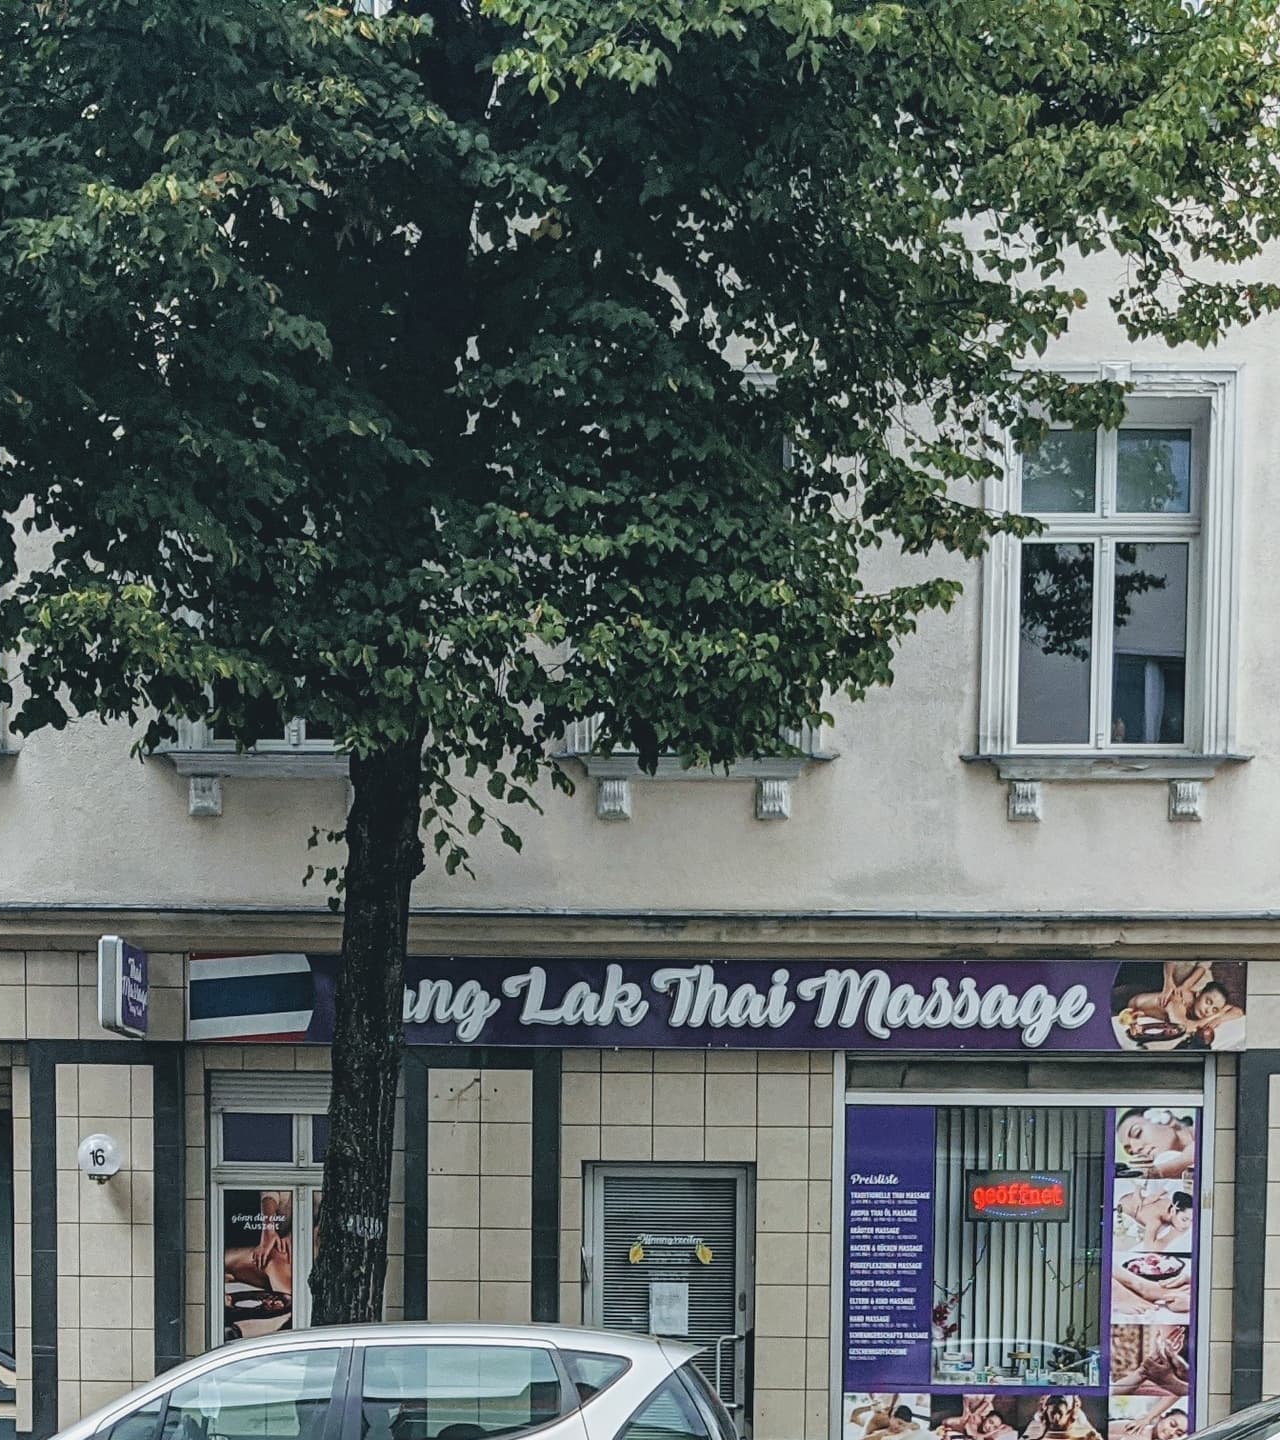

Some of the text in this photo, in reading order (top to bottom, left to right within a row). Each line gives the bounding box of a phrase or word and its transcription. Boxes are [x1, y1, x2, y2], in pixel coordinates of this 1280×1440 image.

[502, 963, 649, 1027] Lak
[651, 963, 796, 1028] Thai
[797, 968, 1096, 1048] Massage
[89, 1148, 106, 1167] 16
[850, 1173, 899, 1185] Preisliste
[906, 1191, 930, 1199] MASSAGE
[973, 1184, 1065, 1210] geöffnet
[892, 1209, 917, 1217] MASSAGE
[243, 1222, 280, 1231] Auszeit
[898, 1244, 923, 1252] MASSAGE
[897, 1262, 923, 1270] MASSAGE
[889, 1297, 914, 1305] MASSAGE
[865, 1315, 890, 1323] MASSAGE
